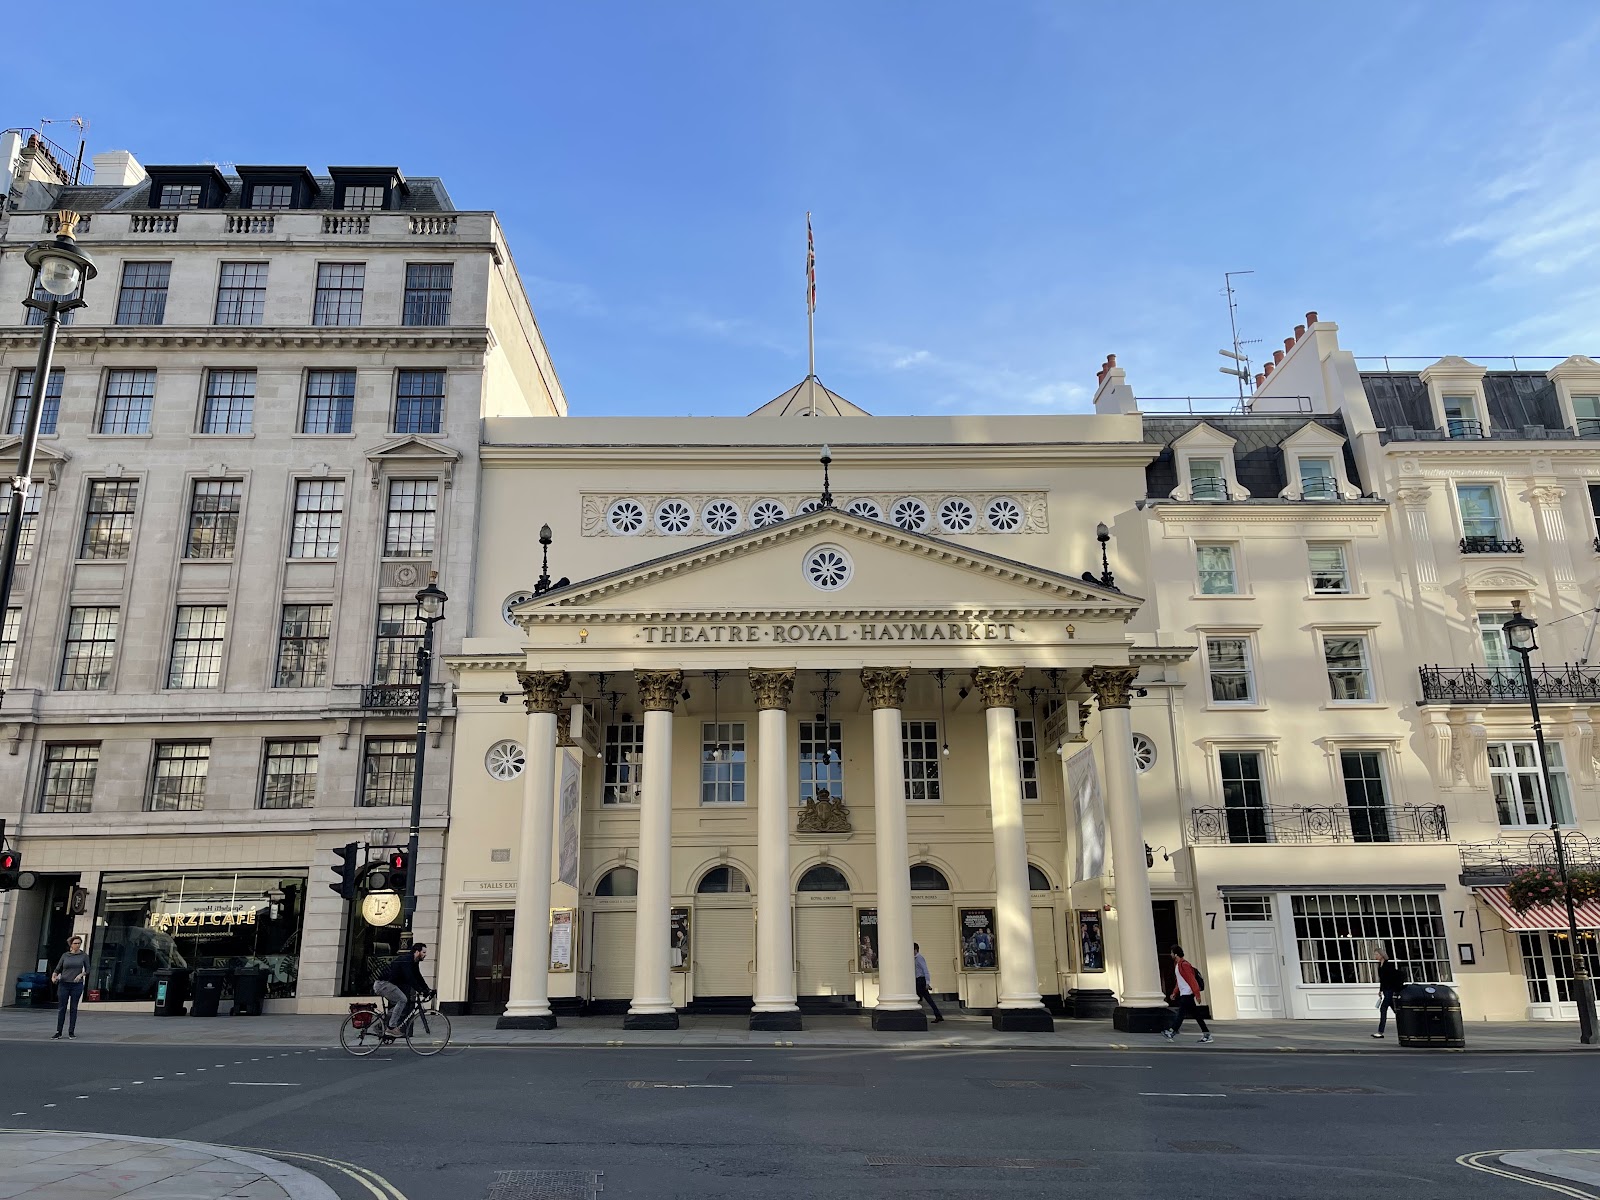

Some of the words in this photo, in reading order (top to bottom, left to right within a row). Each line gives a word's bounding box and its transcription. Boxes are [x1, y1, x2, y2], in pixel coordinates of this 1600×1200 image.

[643, 626, 760, 642] THEATRE
[772, 624, 848, 642] ROYAL
[860, 623, 1015, 640] HAYMARKET
[150, 912, 205, 927] FARZI
[210, 905, 256, 925] CAFÉ
[1205, 912, 1217, 930] 7
[1453, 910, 1465, 928] 7
